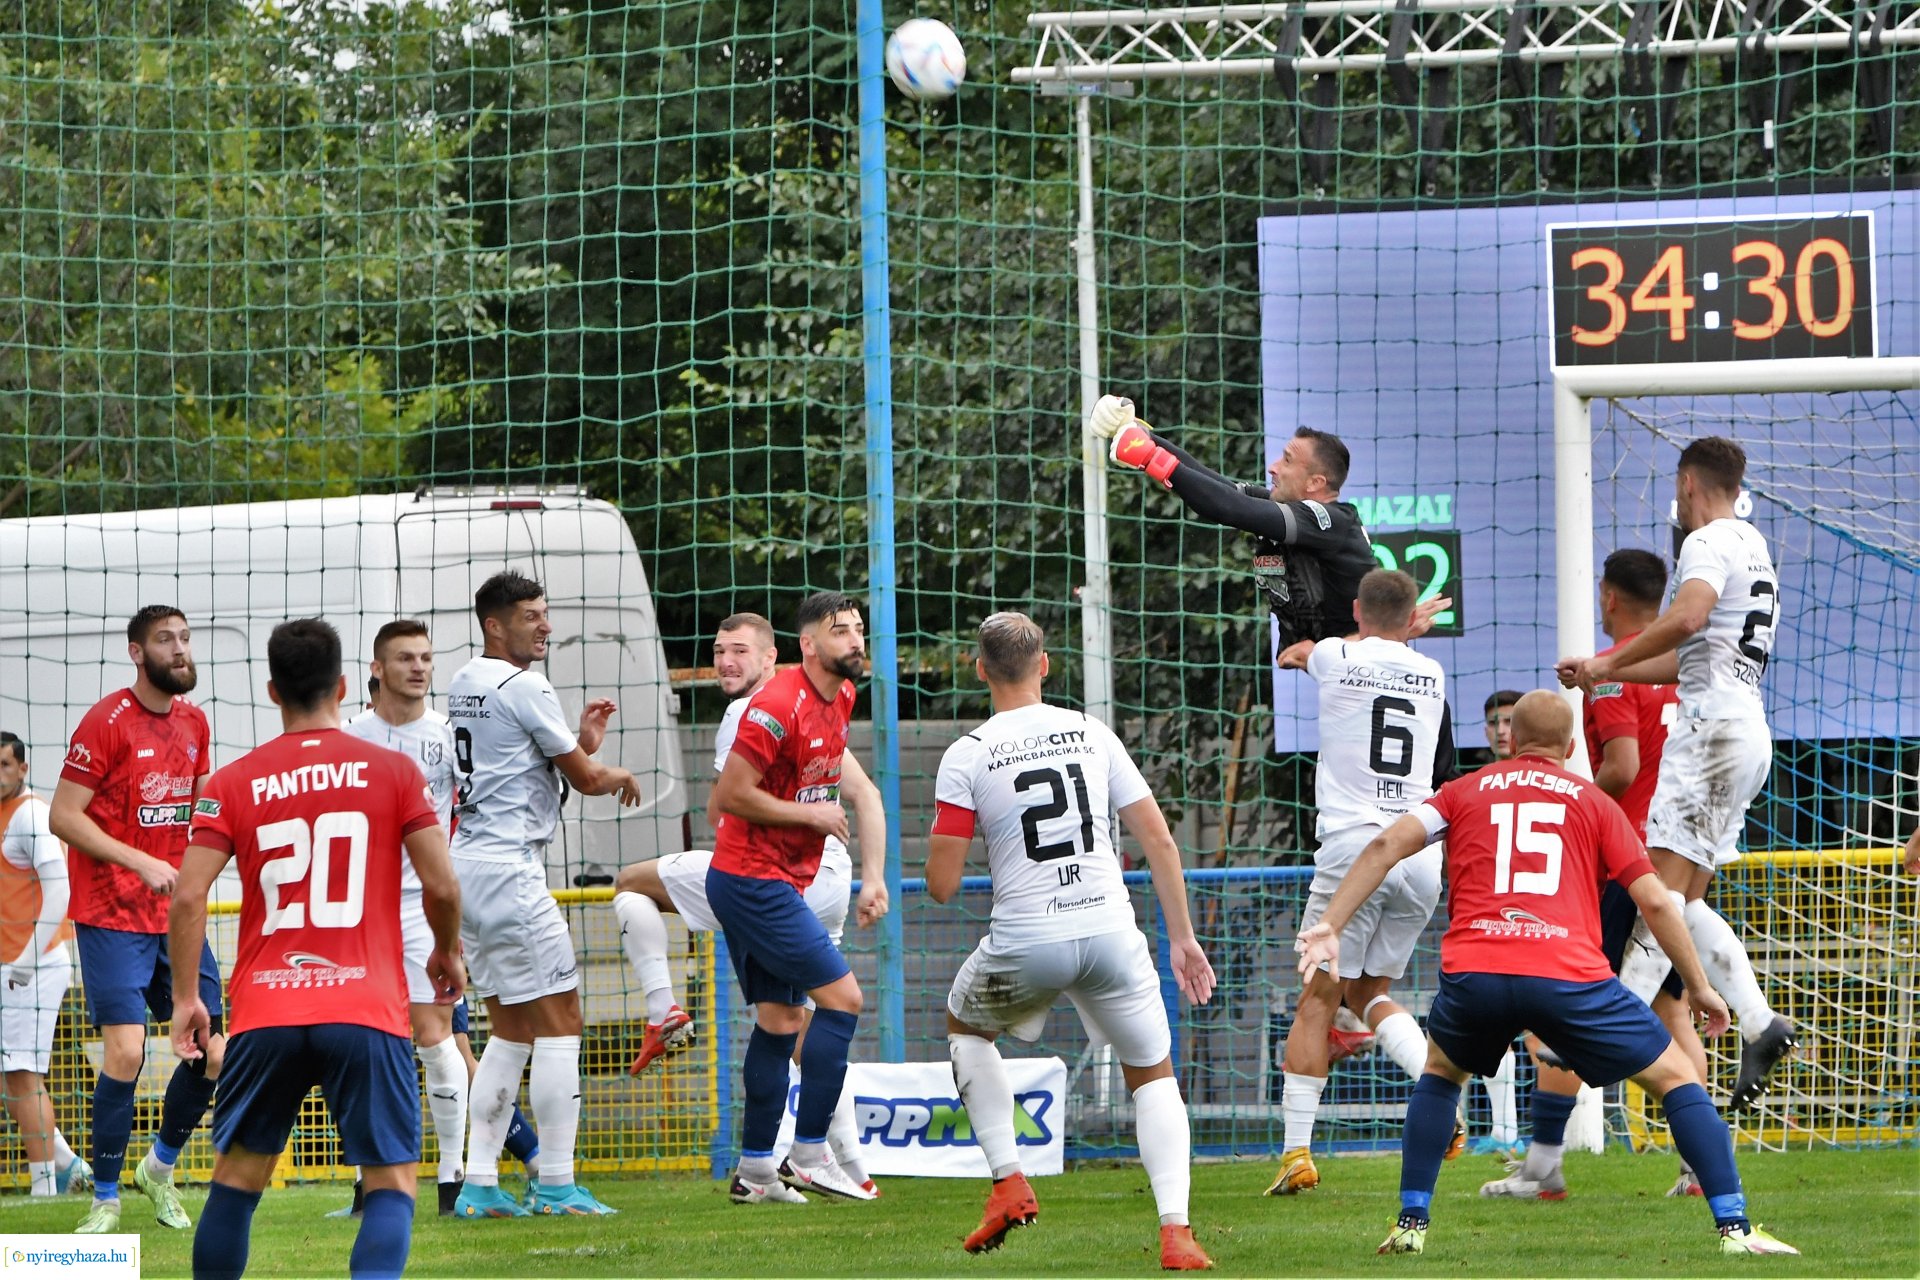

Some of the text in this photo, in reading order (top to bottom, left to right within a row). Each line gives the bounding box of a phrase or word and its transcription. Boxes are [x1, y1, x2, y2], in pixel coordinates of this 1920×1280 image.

[1571, 238, 1855, 346] 34:30
[1350, 494, 1453, 526] HAZAI
[988, 731, 1085, 758] KOLORCITY
[1369, 694, 1416, 777] 6
[988, 746, 1096, 772] KAZINCBARCIKA SC
[251, 761, 369, 806] PANTOVIC
[1376, 779, 1408, 800] HEIL
[1479, 769, 1584, 800] PAPUCSEK
[1013, 763, 1095, 863] 21
[1490, 801, 1566, 896] 15
[255, 811, 369, 936] 20
[1058, 863, 1082, 887] UR
[1057, 895, 1106, 910] BorsodChem
